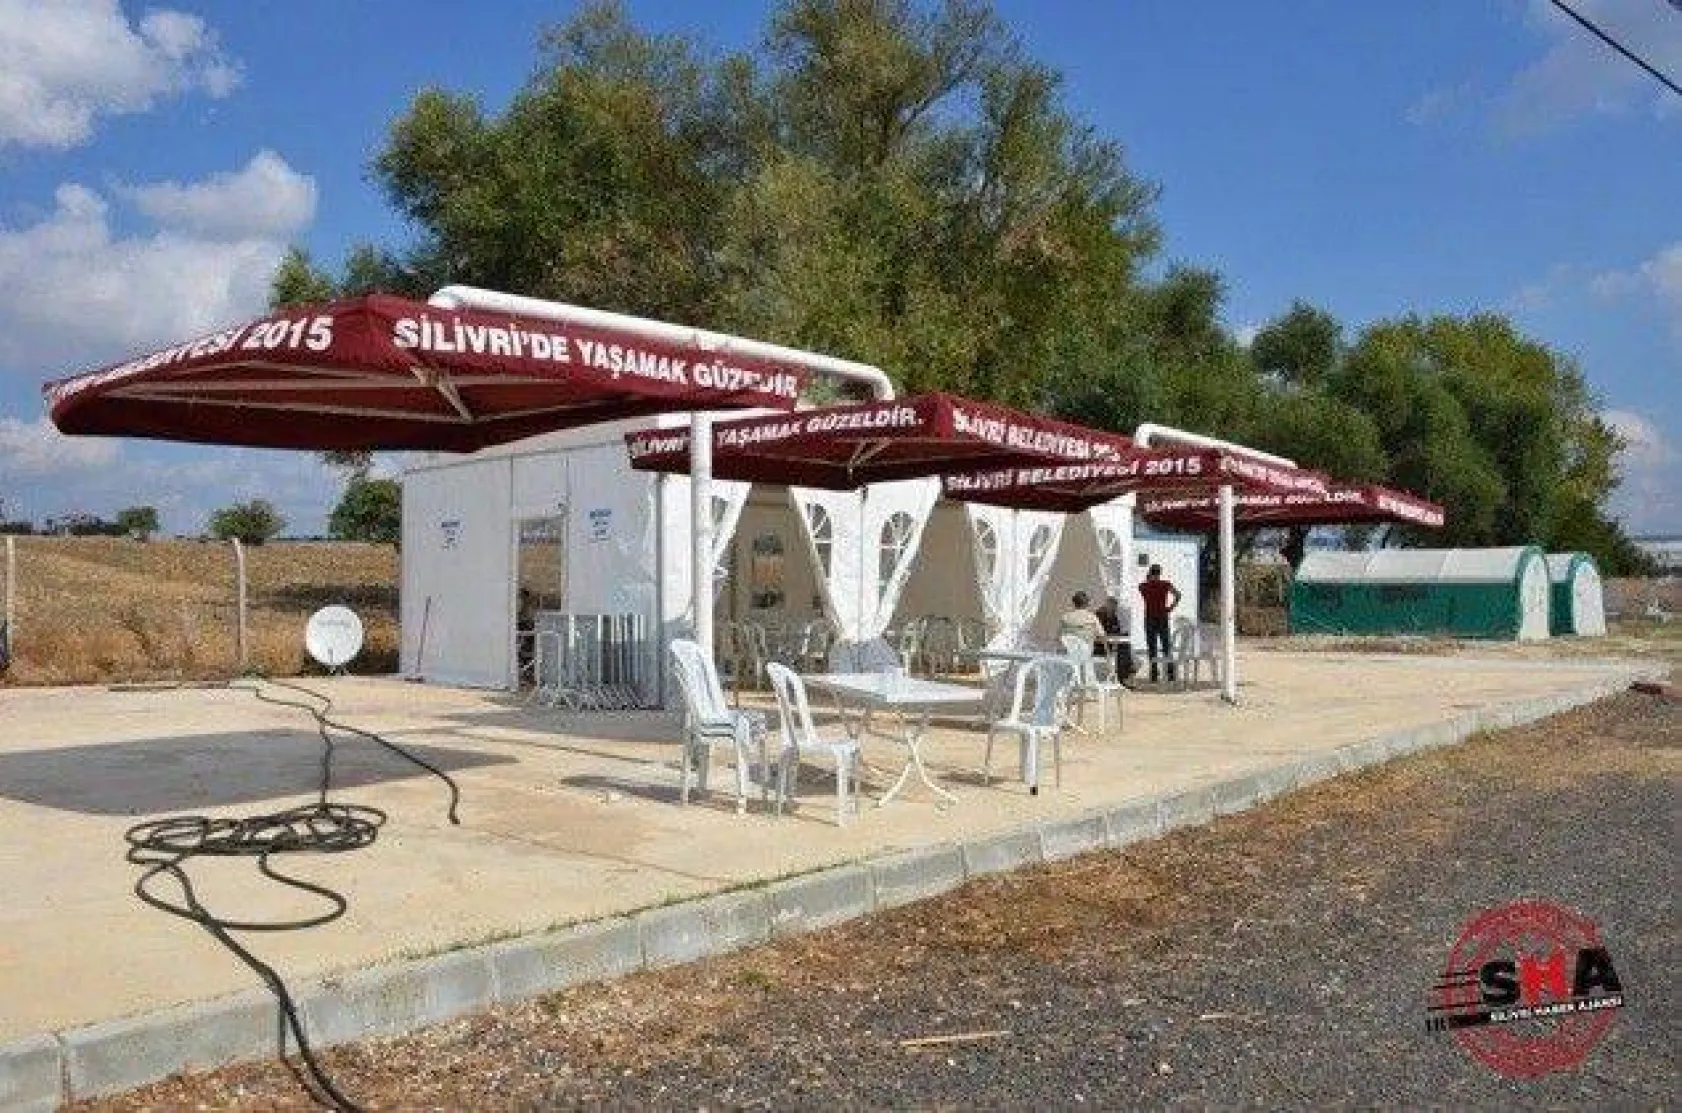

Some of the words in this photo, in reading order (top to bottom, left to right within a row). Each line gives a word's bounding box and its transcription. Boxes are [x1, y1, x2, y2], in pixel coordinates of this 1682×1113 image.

[241, 315, 333, 351] 2015
[393, 314, 571, 362] SİLİVRİ'DE
[574, 338, 688, 385] YAŞAMAK
[716, 421, 801, 447] YAŞAMAK
[1145, 456, 1201, 476] 2015
